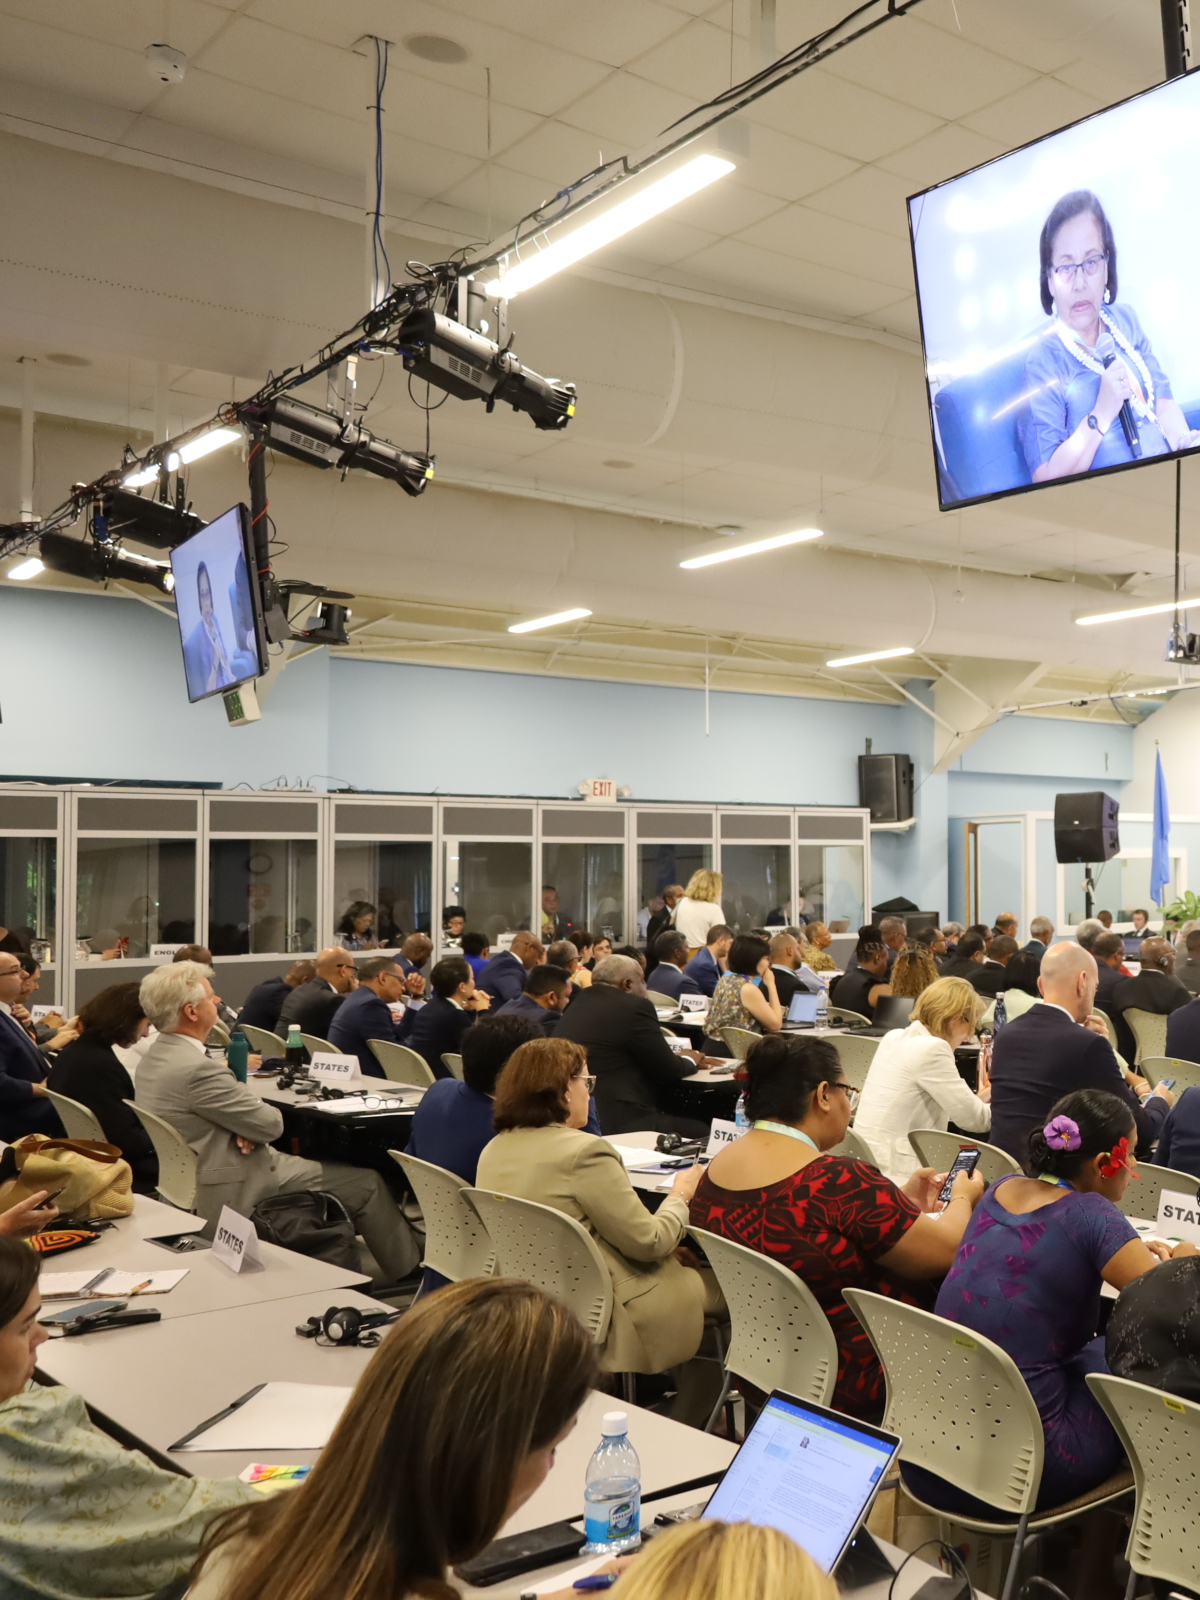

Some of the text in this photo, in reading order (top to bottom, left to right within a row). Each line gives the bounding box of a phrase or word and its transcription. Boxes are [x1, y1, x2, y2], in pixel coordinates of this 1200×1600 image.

[593, 781, 612, 797] EXIT
[313, 1062, 350, 1073] STATES
[217, 1227, 244, 1254] STATES
